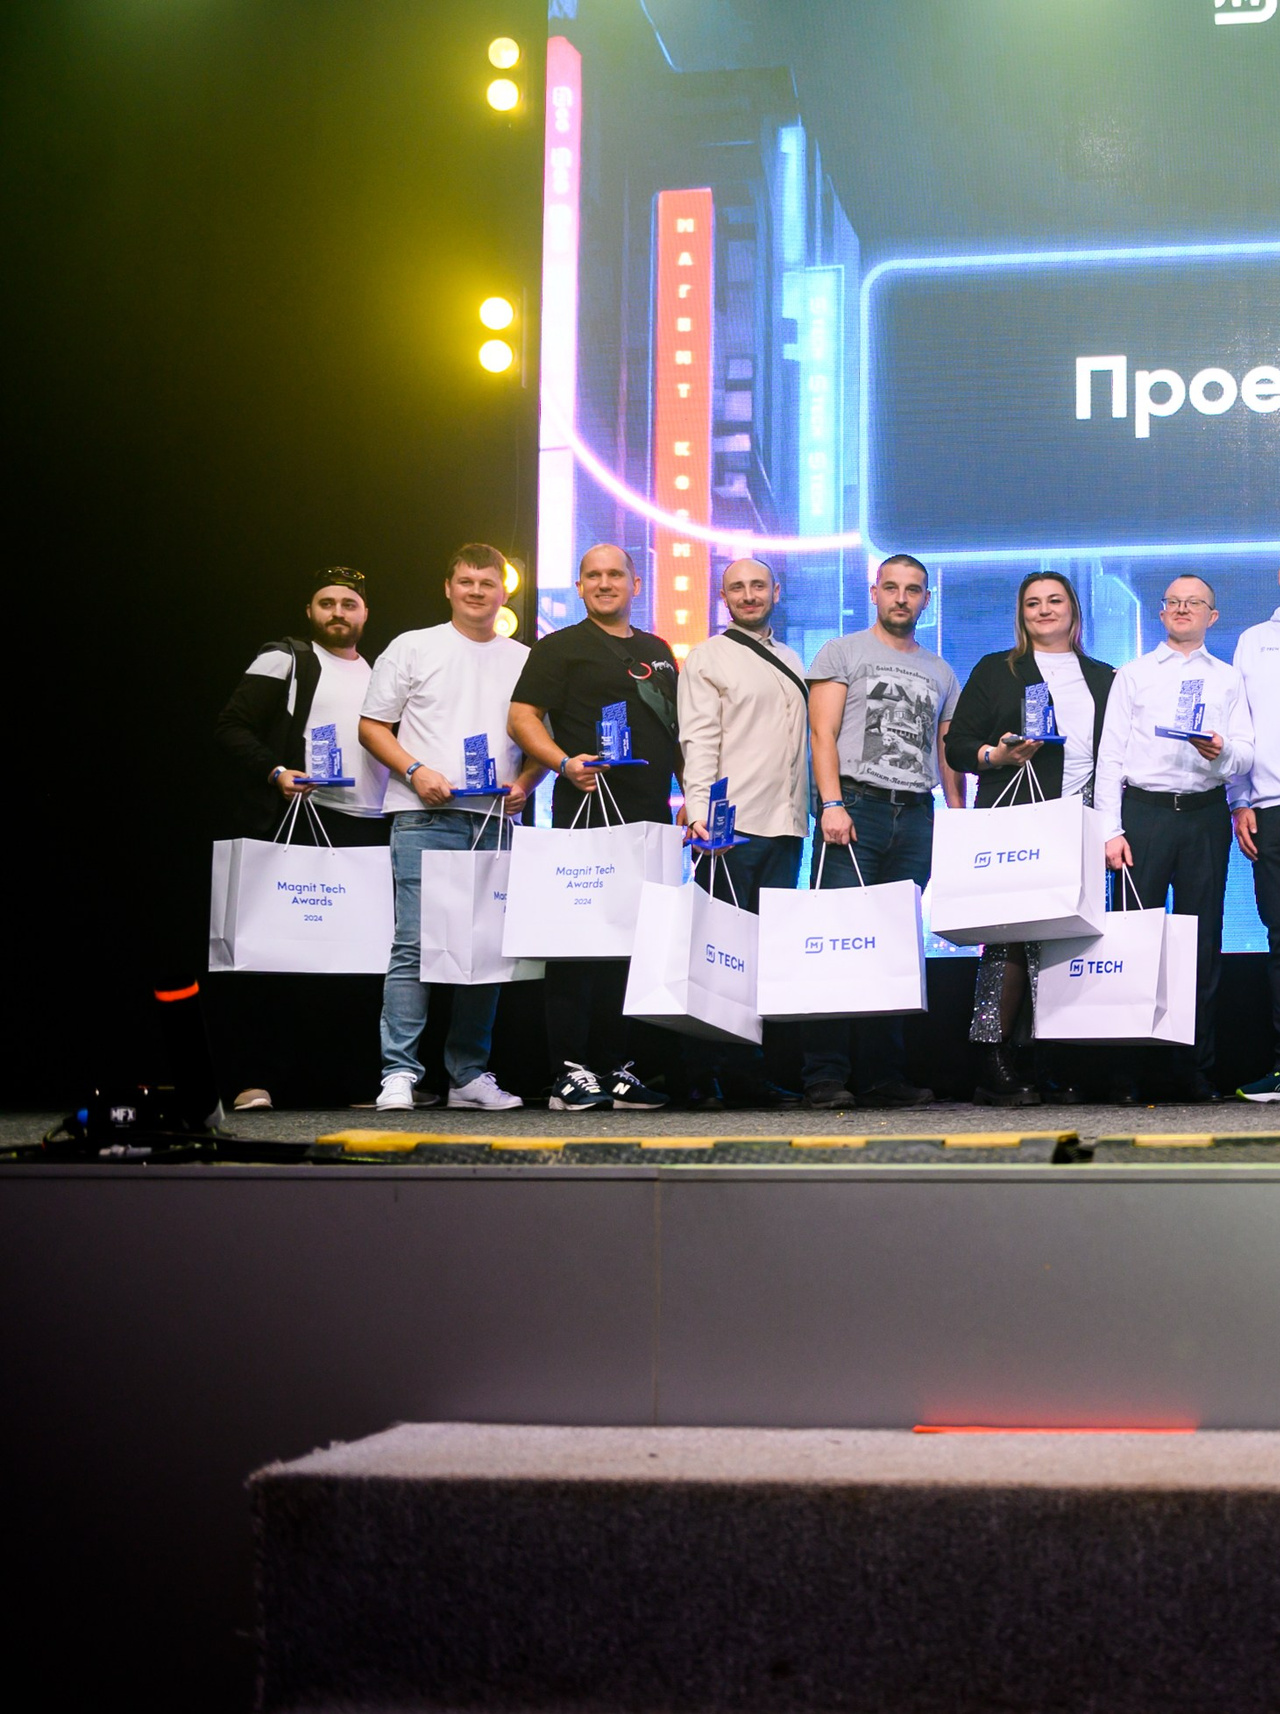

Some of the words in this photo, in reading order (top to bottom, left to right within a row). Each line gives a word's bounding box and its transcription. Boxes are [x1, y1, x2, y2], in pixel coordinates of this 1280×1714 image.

[996, 849, 1040, 863] TECH
[556, 866, 592, 878] Magnit
[595, 864, 615, 875] Tech
[277, 881, 317, 894] Magnit
[320, 884, 346, 894] Tech
[566, 878, 604, 889] Awards
[291, 896, 333, 906] Awards
[829, 936, 876, 950] TECH
[718, 951, 745, 972] TECH
[1087, 960, 1123, 974] TECH
[561, 1083, 575, 1096] N
[612, 1082, 631, 1095] N
[111, 1108, 134, 1121] MFX
